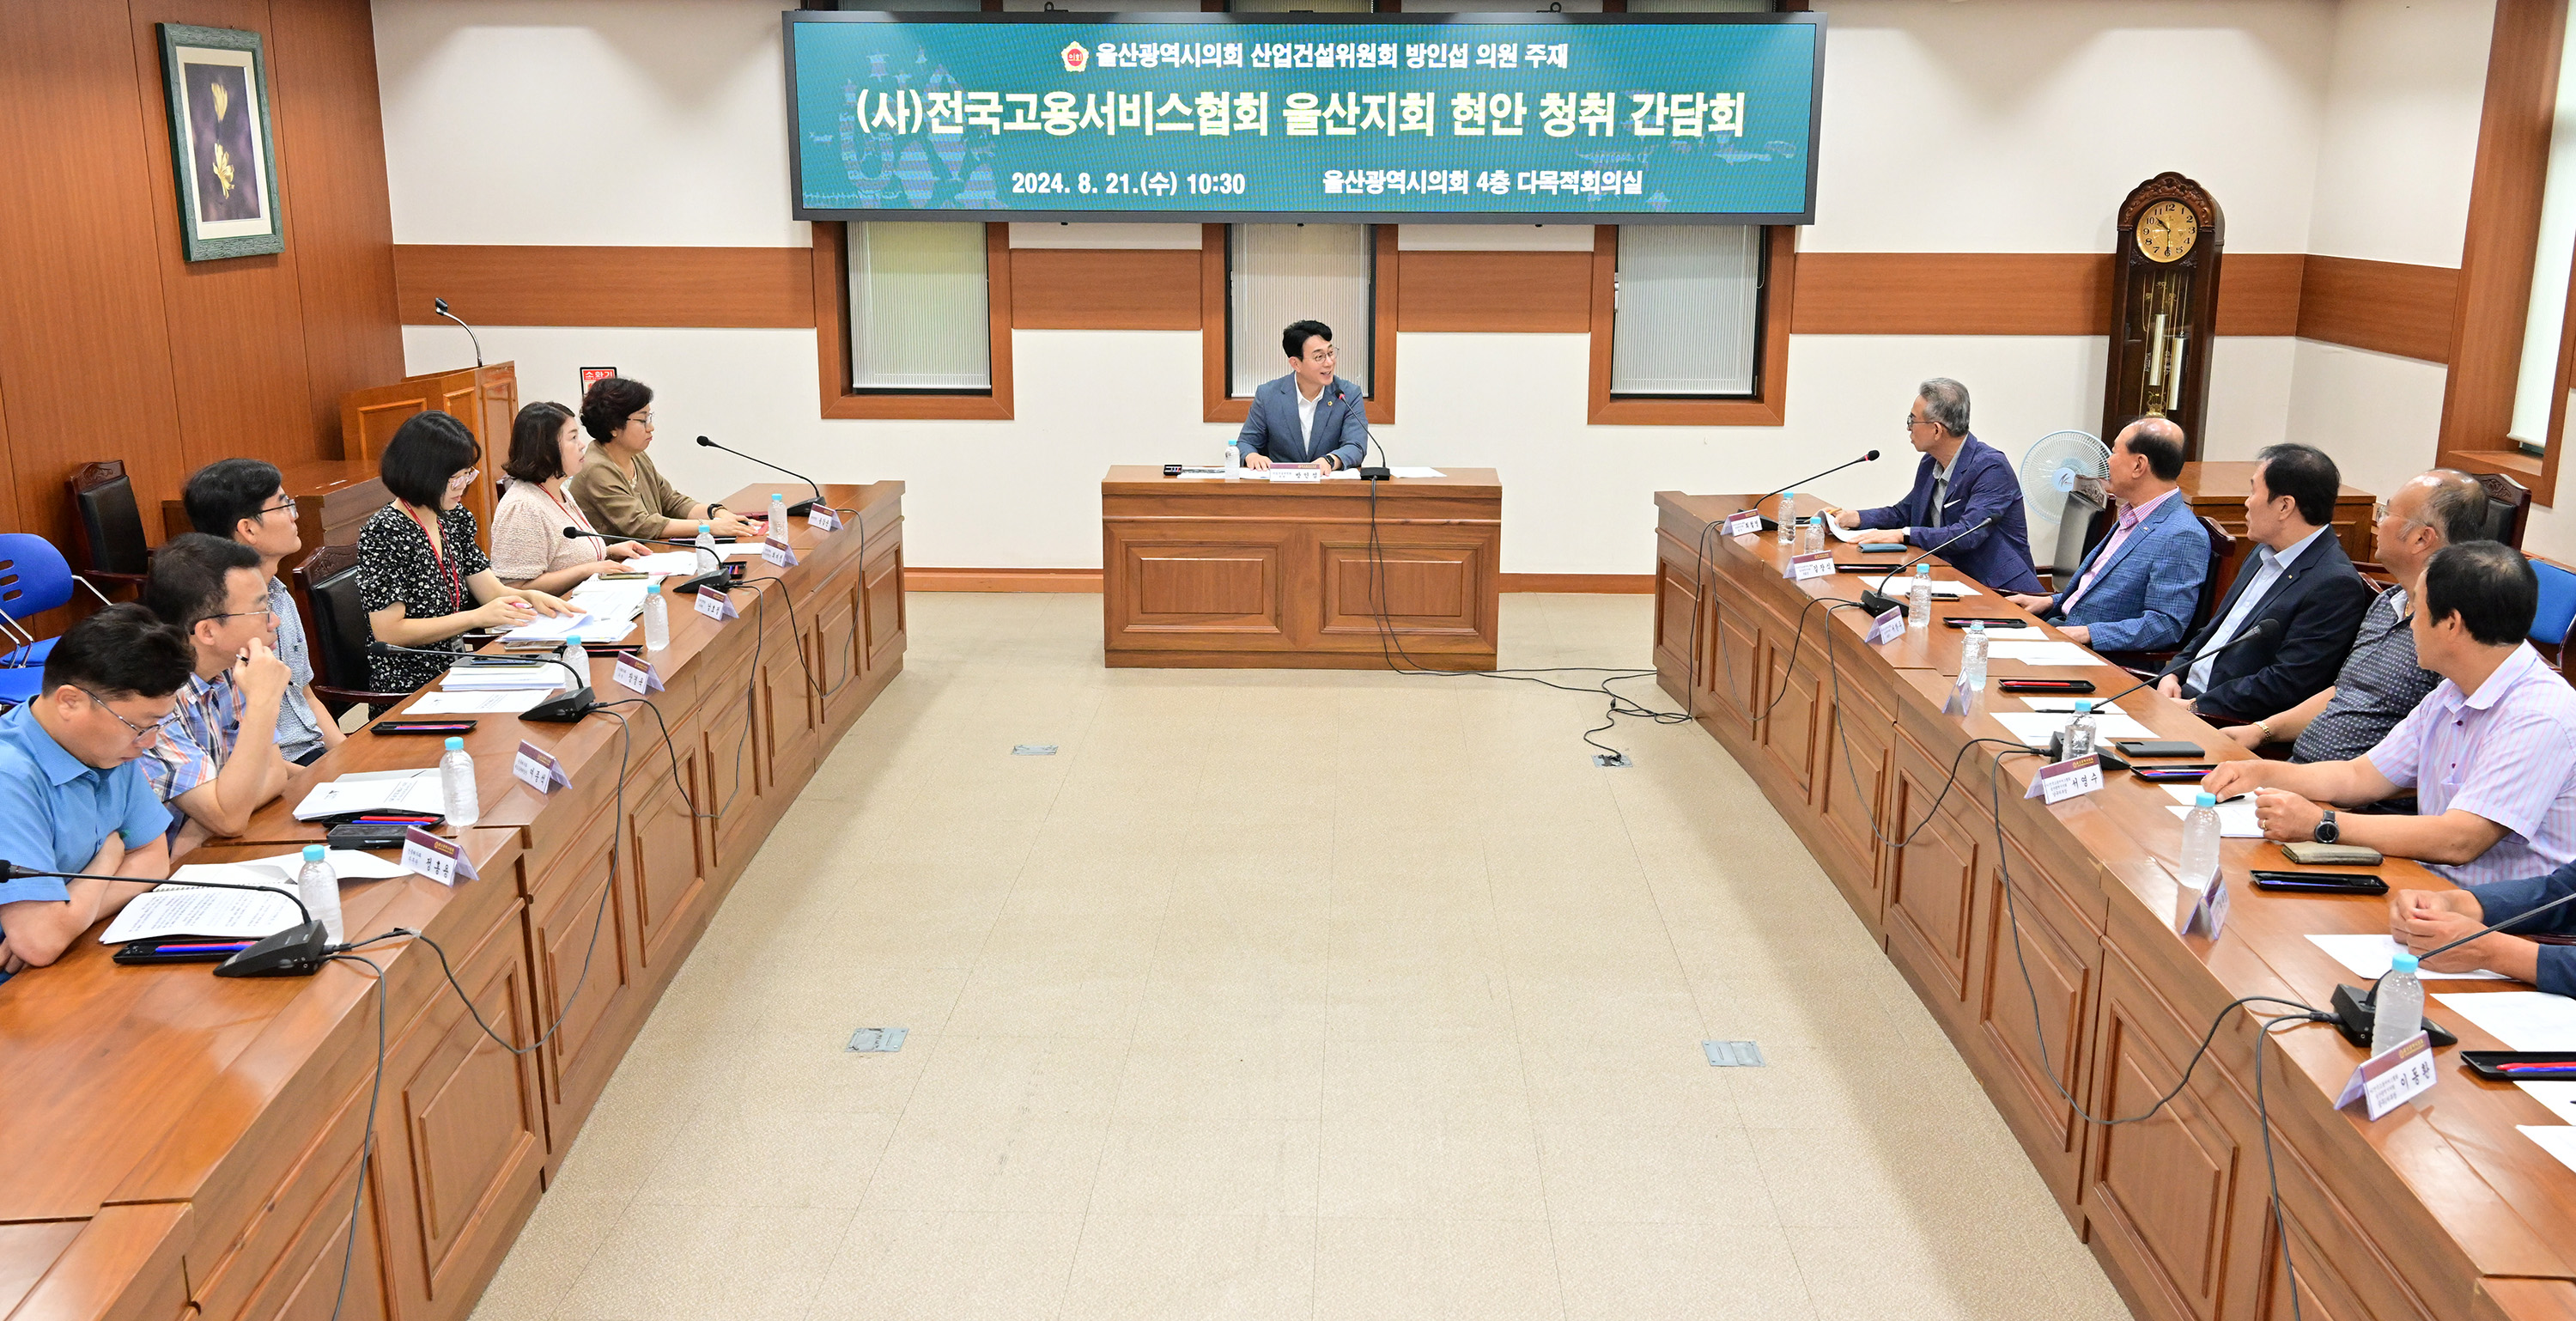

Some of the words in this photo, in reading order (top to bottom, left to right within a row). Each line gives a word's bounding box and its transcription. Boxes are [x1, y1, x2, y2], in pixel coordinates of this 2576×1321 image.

[1096, 42, 1242, 68] 울산광역시의회
[1250, 43, 1398, 69] 산업건설위원회
[1406, 43, 1468, 69] 방인섭
[1476, 43, 1518, 69] 의원
[1524, 43, 1568, 69] 주재
[857, 88, 1268, 137] (사)전국고용서비스협회
[1283, 91, 1435, 137] 울산지회
[1451, 92, 1528, 137] 현안
[1539, 92, 1615, 137] 청취
[1631, 92, 1745, 137] 간담회
[1012, 172, 1070, 194] 2024.
[1078, 172, 1098, 194] 8.
[1106, 171, 1177, 197] 21.(수)
[1187, 173, 1246, 195] 10:30
[1322, 169, 1468, 195] 울산광역시의회
[1476, 169, 1511, 195] 4층
[1517, 170, 1643, 195] 다목적회의실
